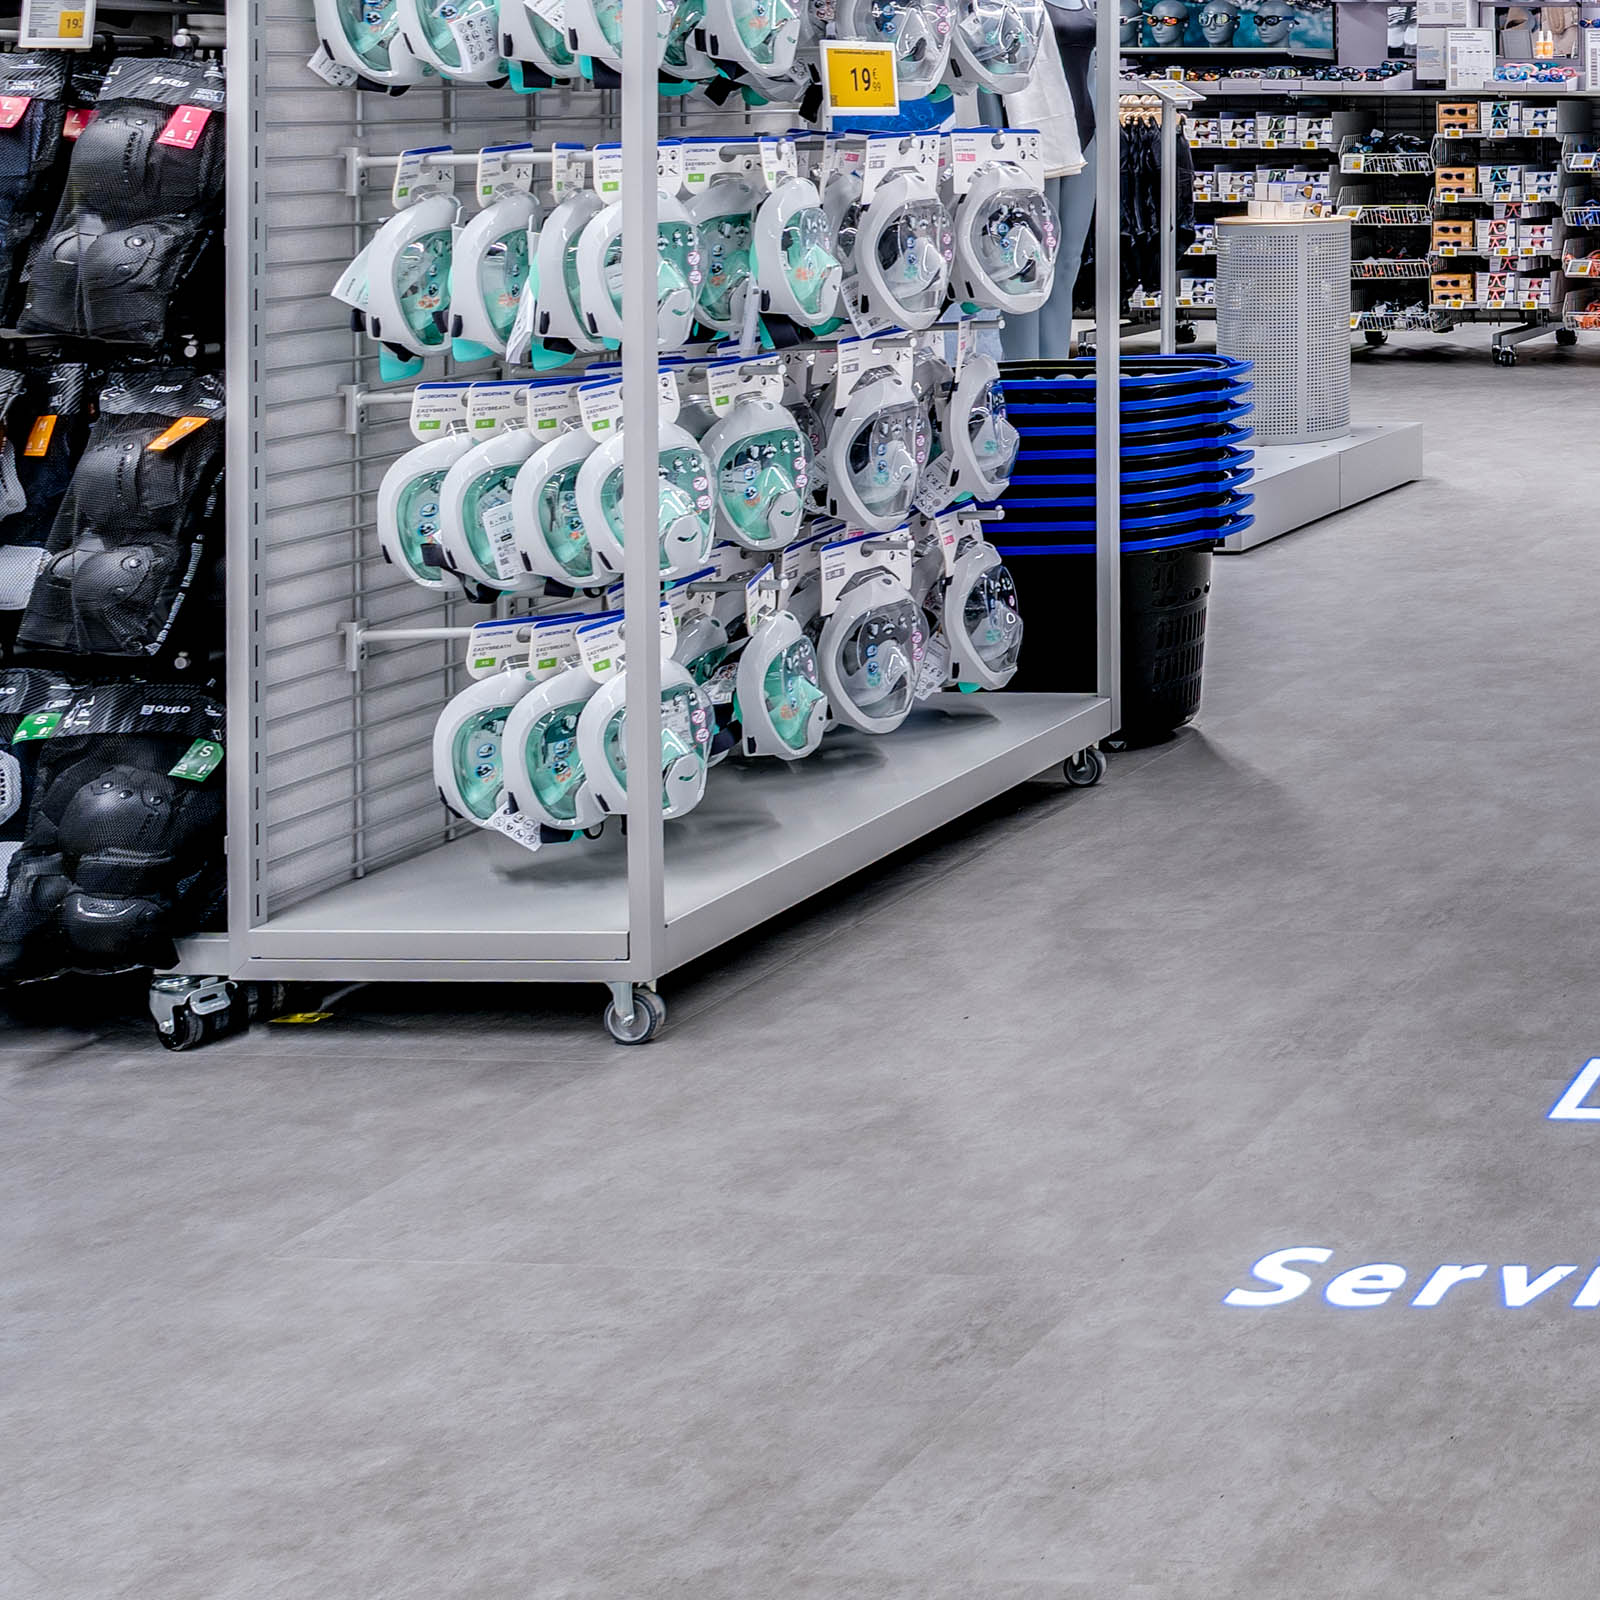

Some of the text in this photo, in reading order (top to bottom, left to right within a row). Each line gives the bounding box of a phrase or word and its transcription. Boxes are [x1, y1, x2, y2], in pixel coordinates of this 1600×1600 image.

[850, 67, 871, 91] 19
[182, 112, 192, 123] L
[33, 715, 48, 724] S
[200, 745, 214, 757] S
